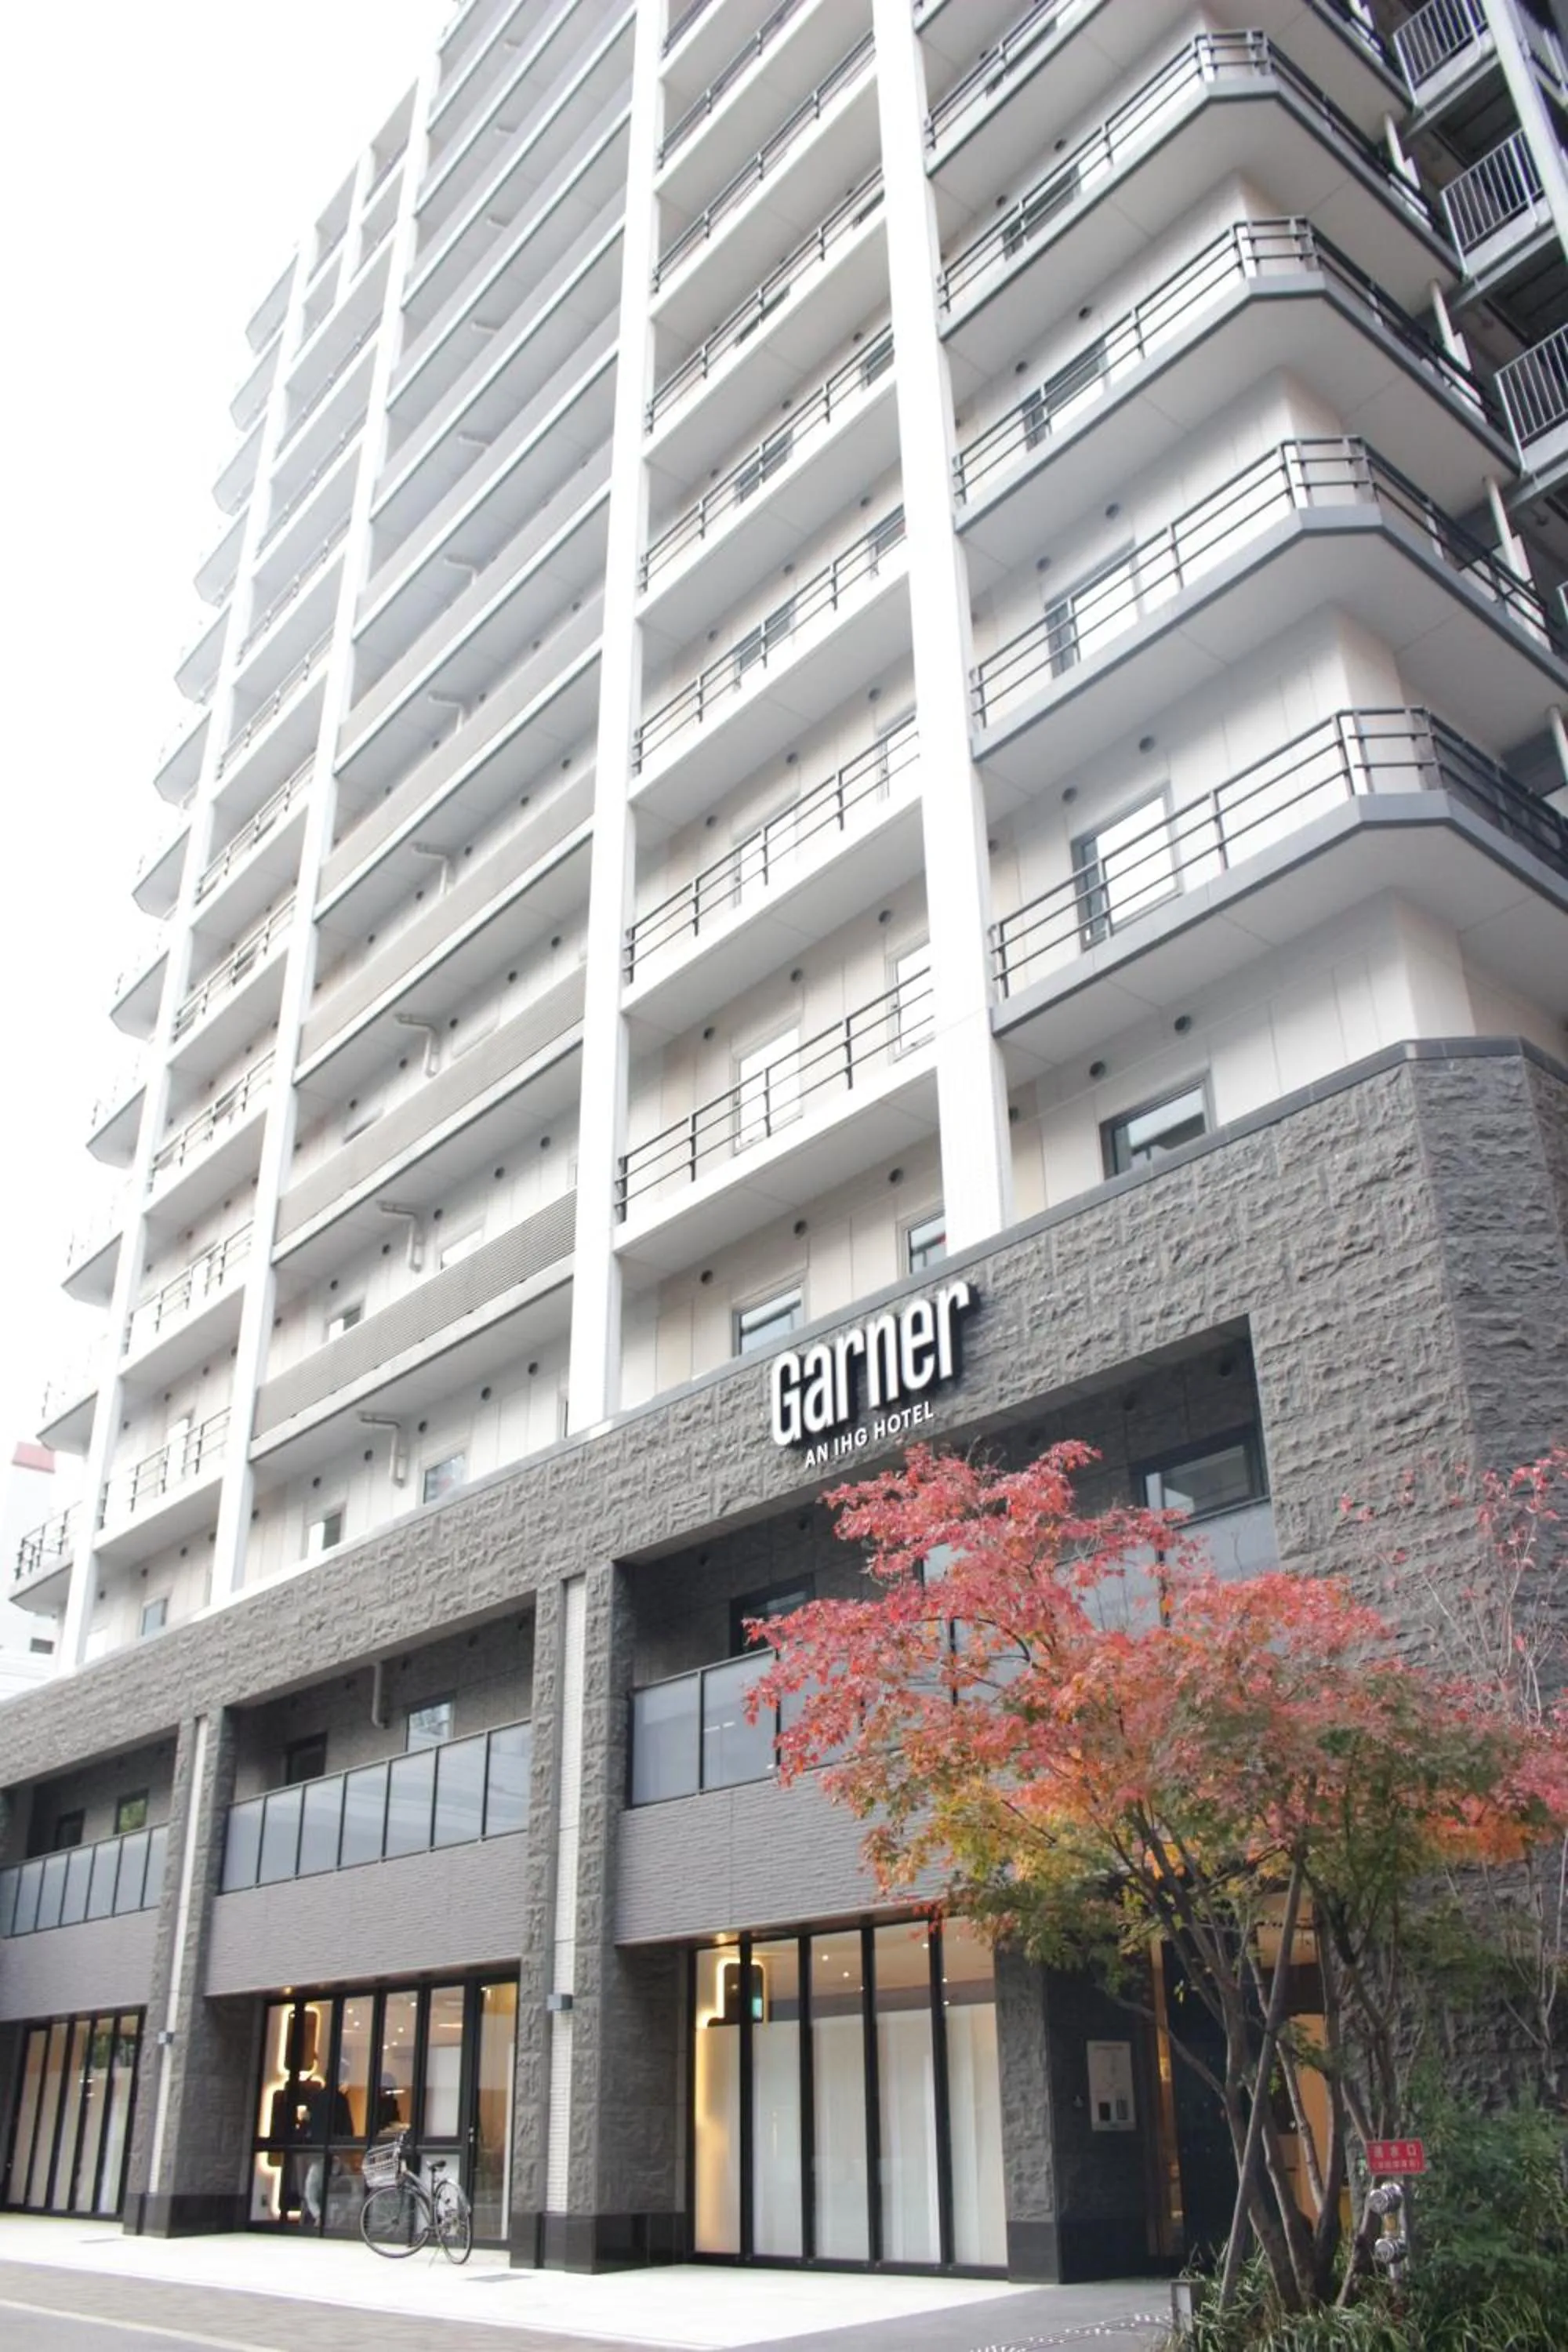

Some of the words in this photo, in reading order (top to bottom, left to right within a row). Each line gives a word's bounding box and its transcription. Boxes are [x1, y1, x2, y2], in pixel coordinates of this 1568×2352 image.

[771, 1281, 970, 1446] Garner
[804, 1443, 829, 1469] AN
[833, 1427, 869, 1456] IHG
[873, 1400, 935, 1440] HOTEL
